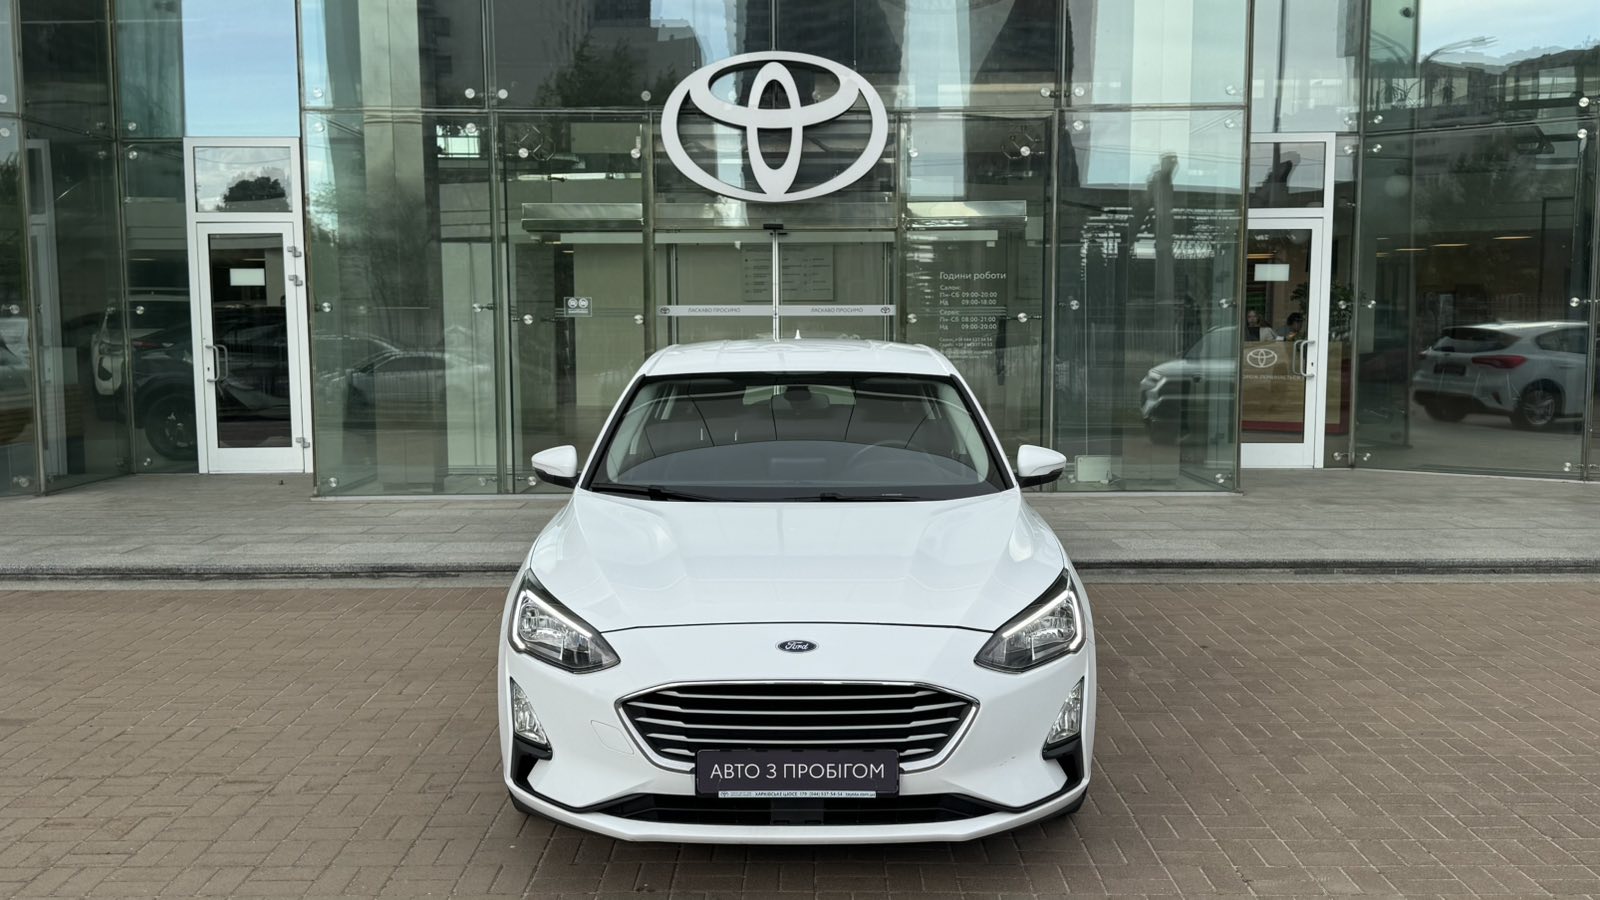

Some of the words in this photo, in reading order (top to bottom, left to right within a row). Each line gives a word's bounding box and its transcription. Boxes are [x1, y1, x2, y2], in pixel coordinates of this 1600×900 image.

[939, 271, 972, 280] Години
[973, 271, 1007, 280] роботи
[785, 641, 809, 650] Ford
[710, 763, 761, 779] АВТО
[766, 763, 777, 779] З
[783, 763, 885, 779] ПРОБІГОМ
